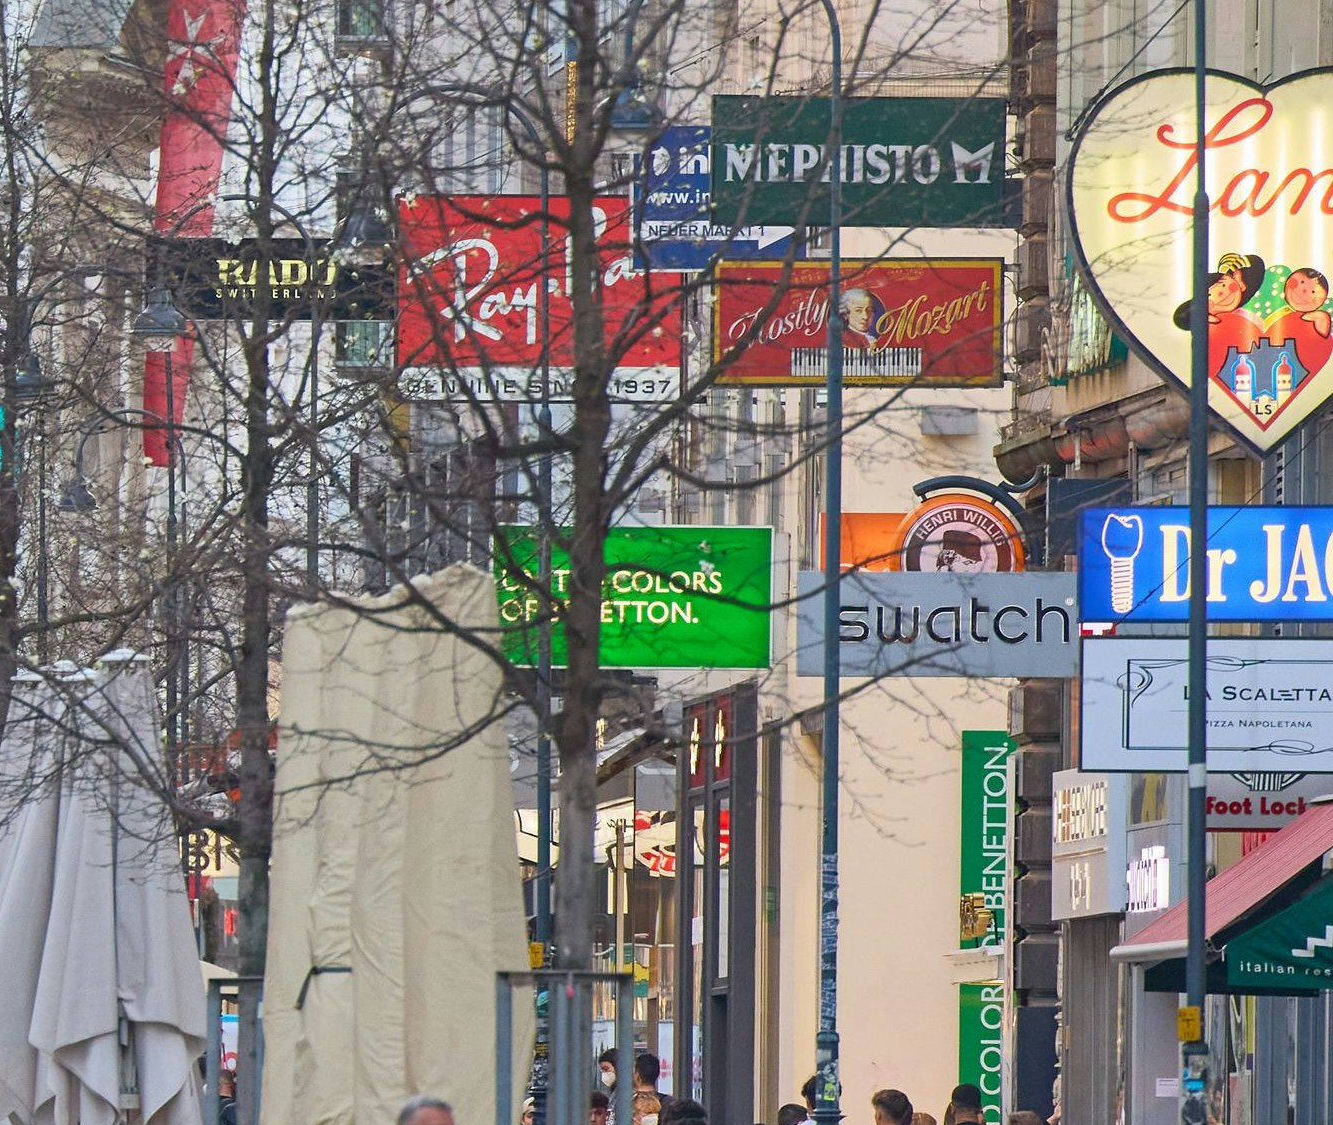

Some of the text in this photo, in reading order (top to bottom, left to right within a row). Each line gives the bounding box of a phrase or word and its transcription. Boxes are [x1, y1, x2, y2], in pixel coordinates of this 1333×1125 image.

[679, 146, 711, 175] in
[724, 143, 941, 185] MEPHISTO
[648, 225, 698, 237] NEUER
[703, 225, 755, 237] MARKT
[216, 259, 338, 286] RADO
[407, 207, 645, 345] Ray-Ba
[215, 288, 338, 299] SWITERLND
[873, 280, 990, 354] Mozart
[407, 379, 516, 394] GENINE
[613, 380, 672, 394] 1937
[1255, 403, 1273, 416] LS
[915, 509, 1006, 547] HENRI WILLIG
[1159, 523, 1333, 604] Dr JA
[612, 570, 723, 594] COLORS
[501, 599, 538, 622] OF
[838, 597, 1071, 644] swatch
[1238, 719, 1313, 728] NAPOLETANA
[1206, 795, 1253, 816] Foot
[983, 741, 1009, 910] BENETTON.
[1240, 961, 1295, 975] italian
